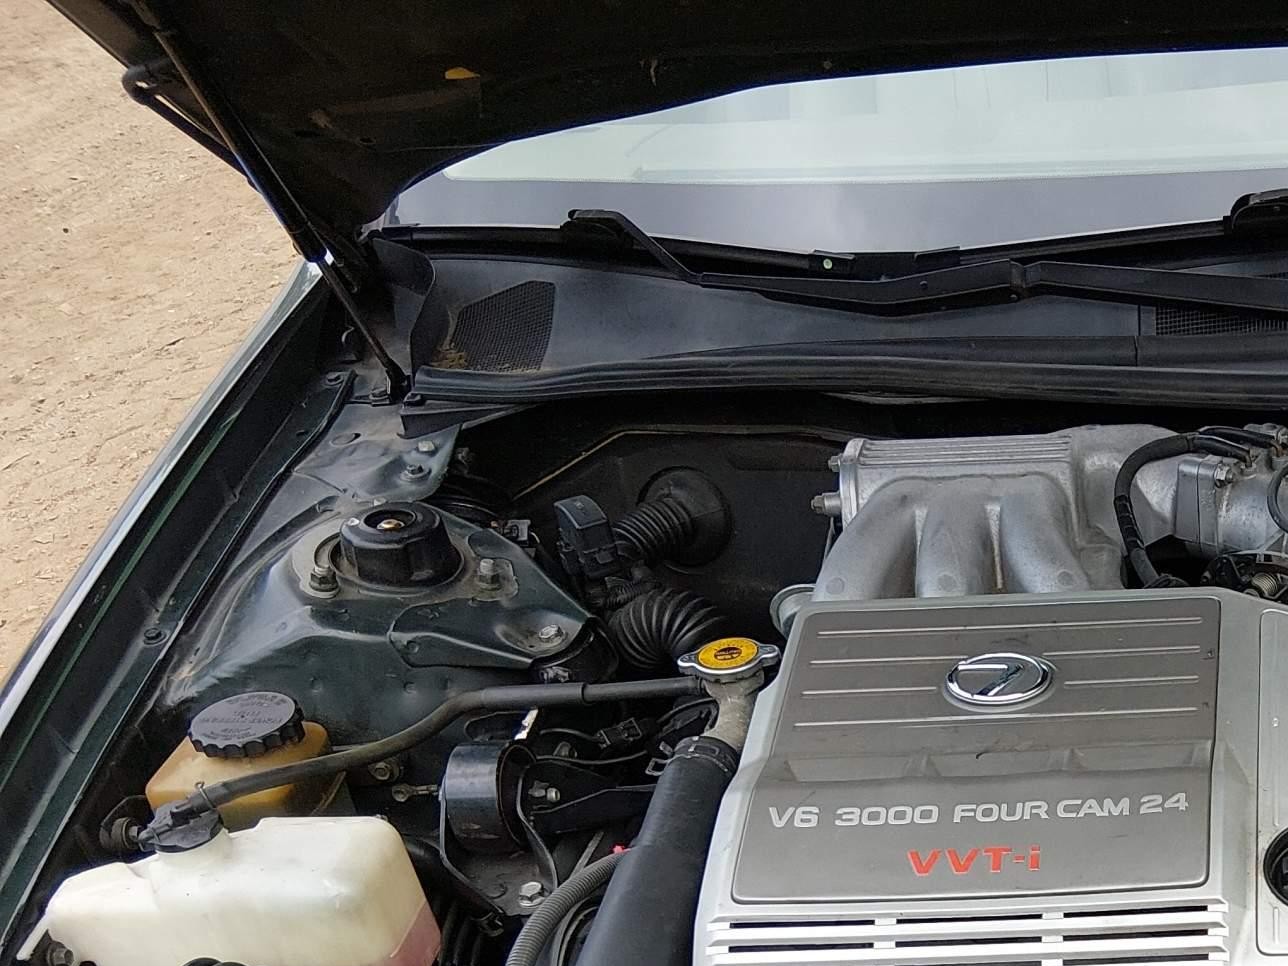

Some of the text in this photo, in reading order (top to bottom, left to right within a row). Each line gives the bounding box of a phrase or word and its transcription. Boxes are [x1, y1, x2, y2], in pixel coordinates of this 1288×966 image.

[768, 792, 1189, 829] V6 3000 FOUR CAM 24
[907, 844, 1042, 877] VVT-i
